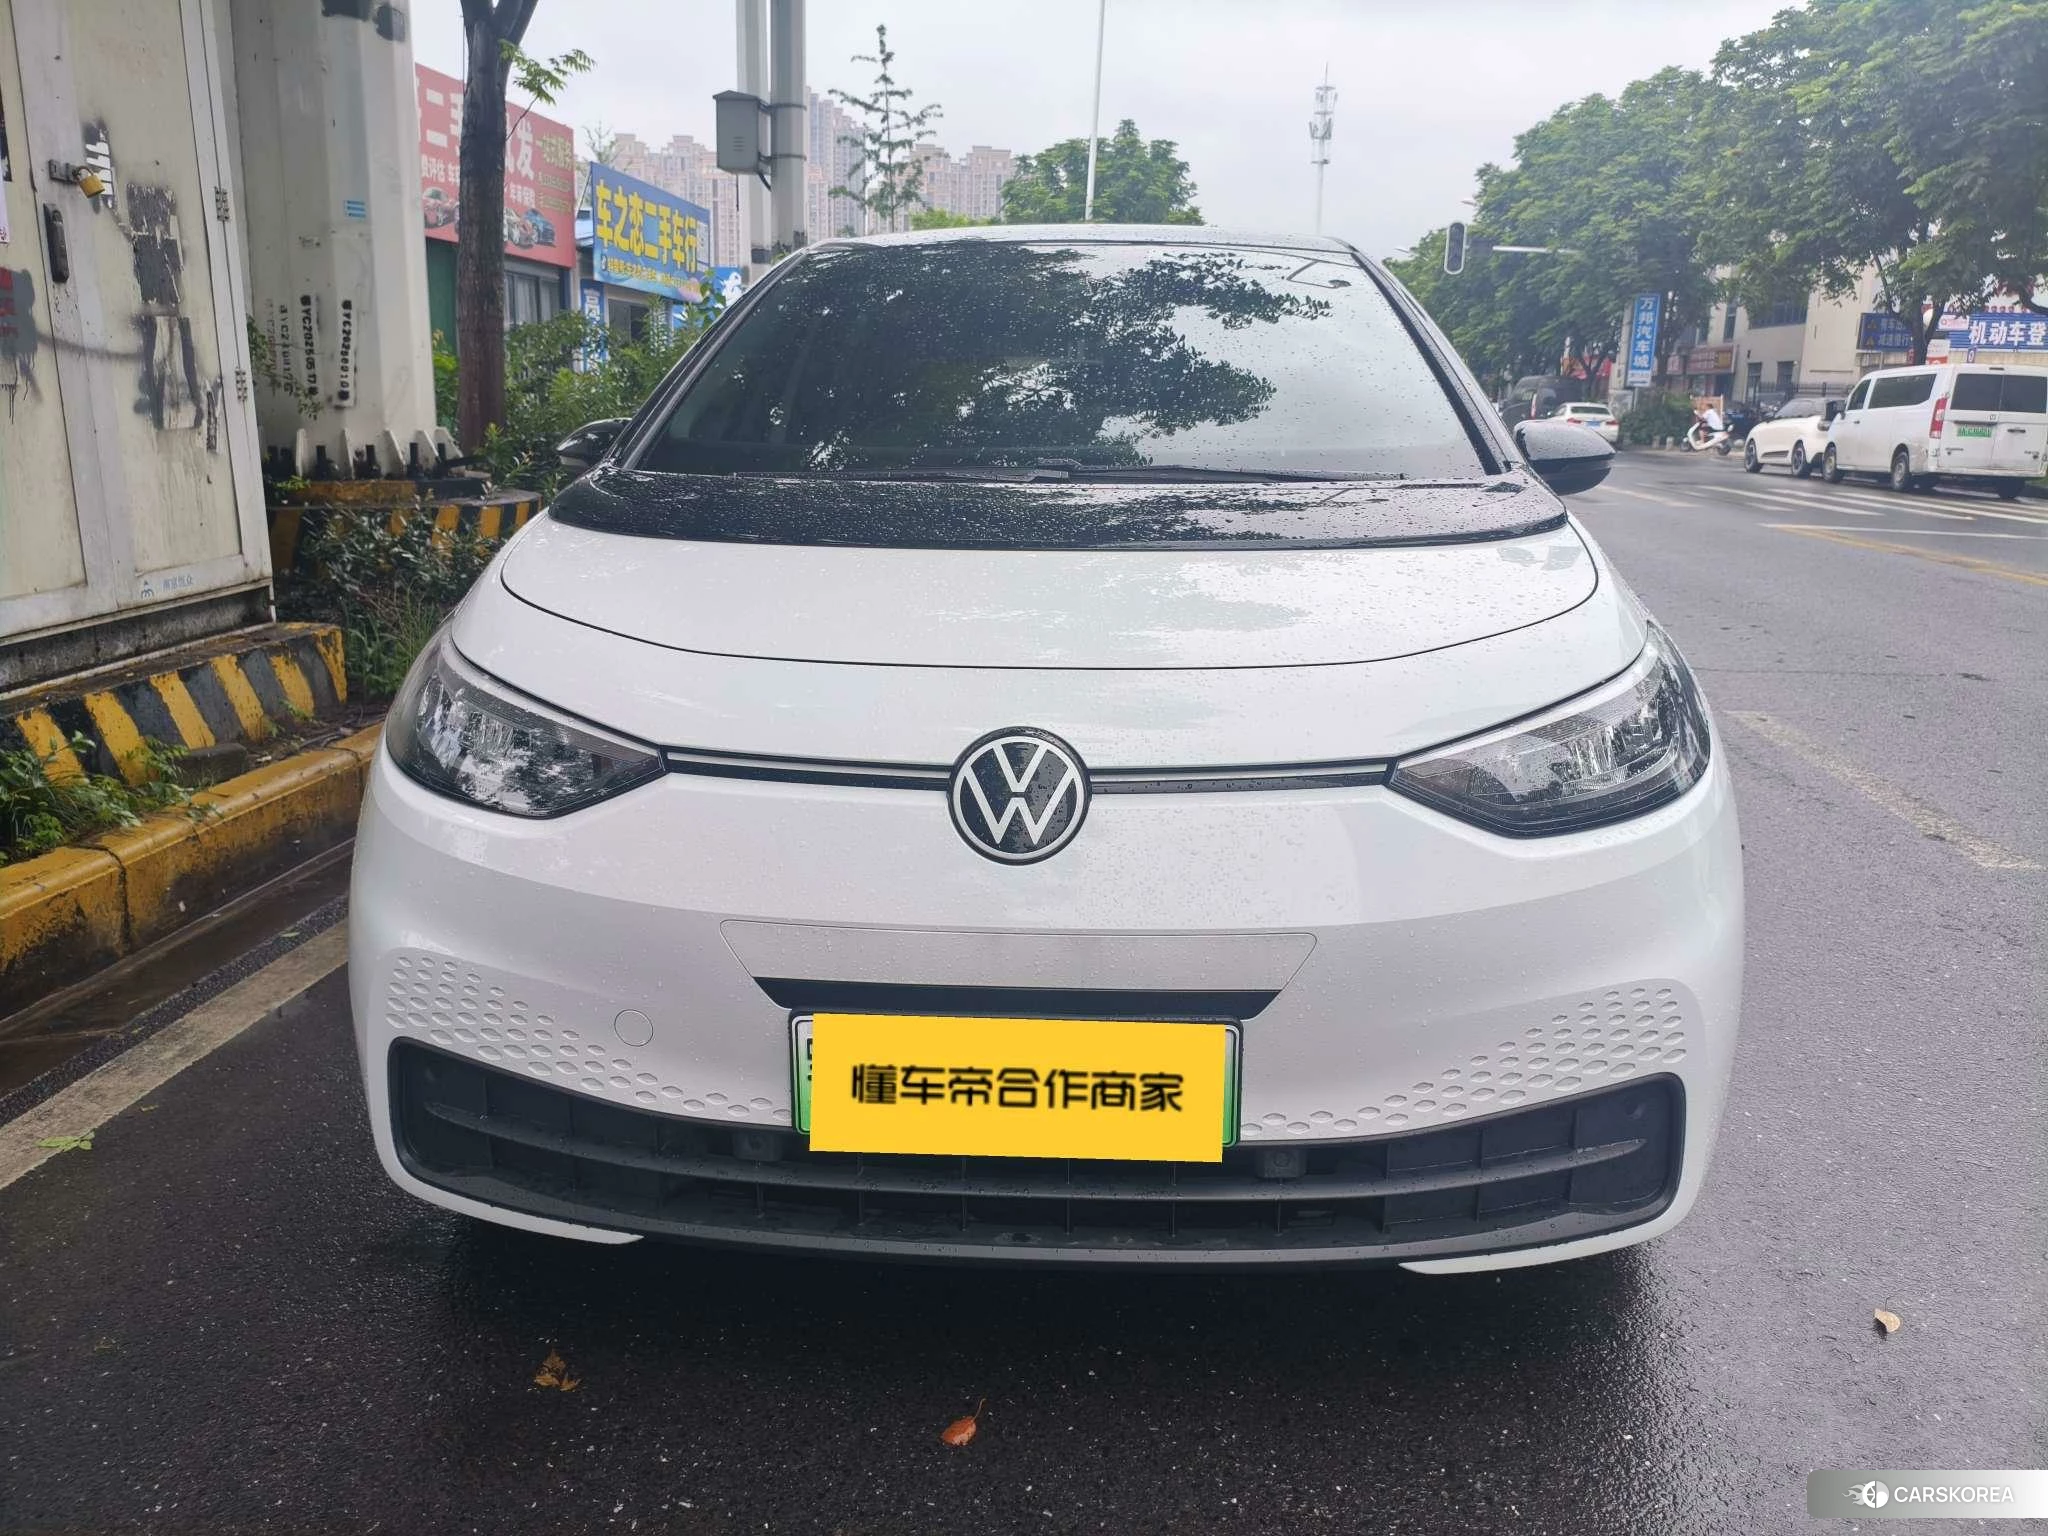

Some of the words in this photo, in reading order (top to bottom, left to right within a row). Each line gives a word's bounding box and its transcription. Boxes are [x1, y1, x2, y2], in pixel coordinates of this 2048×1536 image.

[1631, 297, 1655, 368] 万邦汽车城
